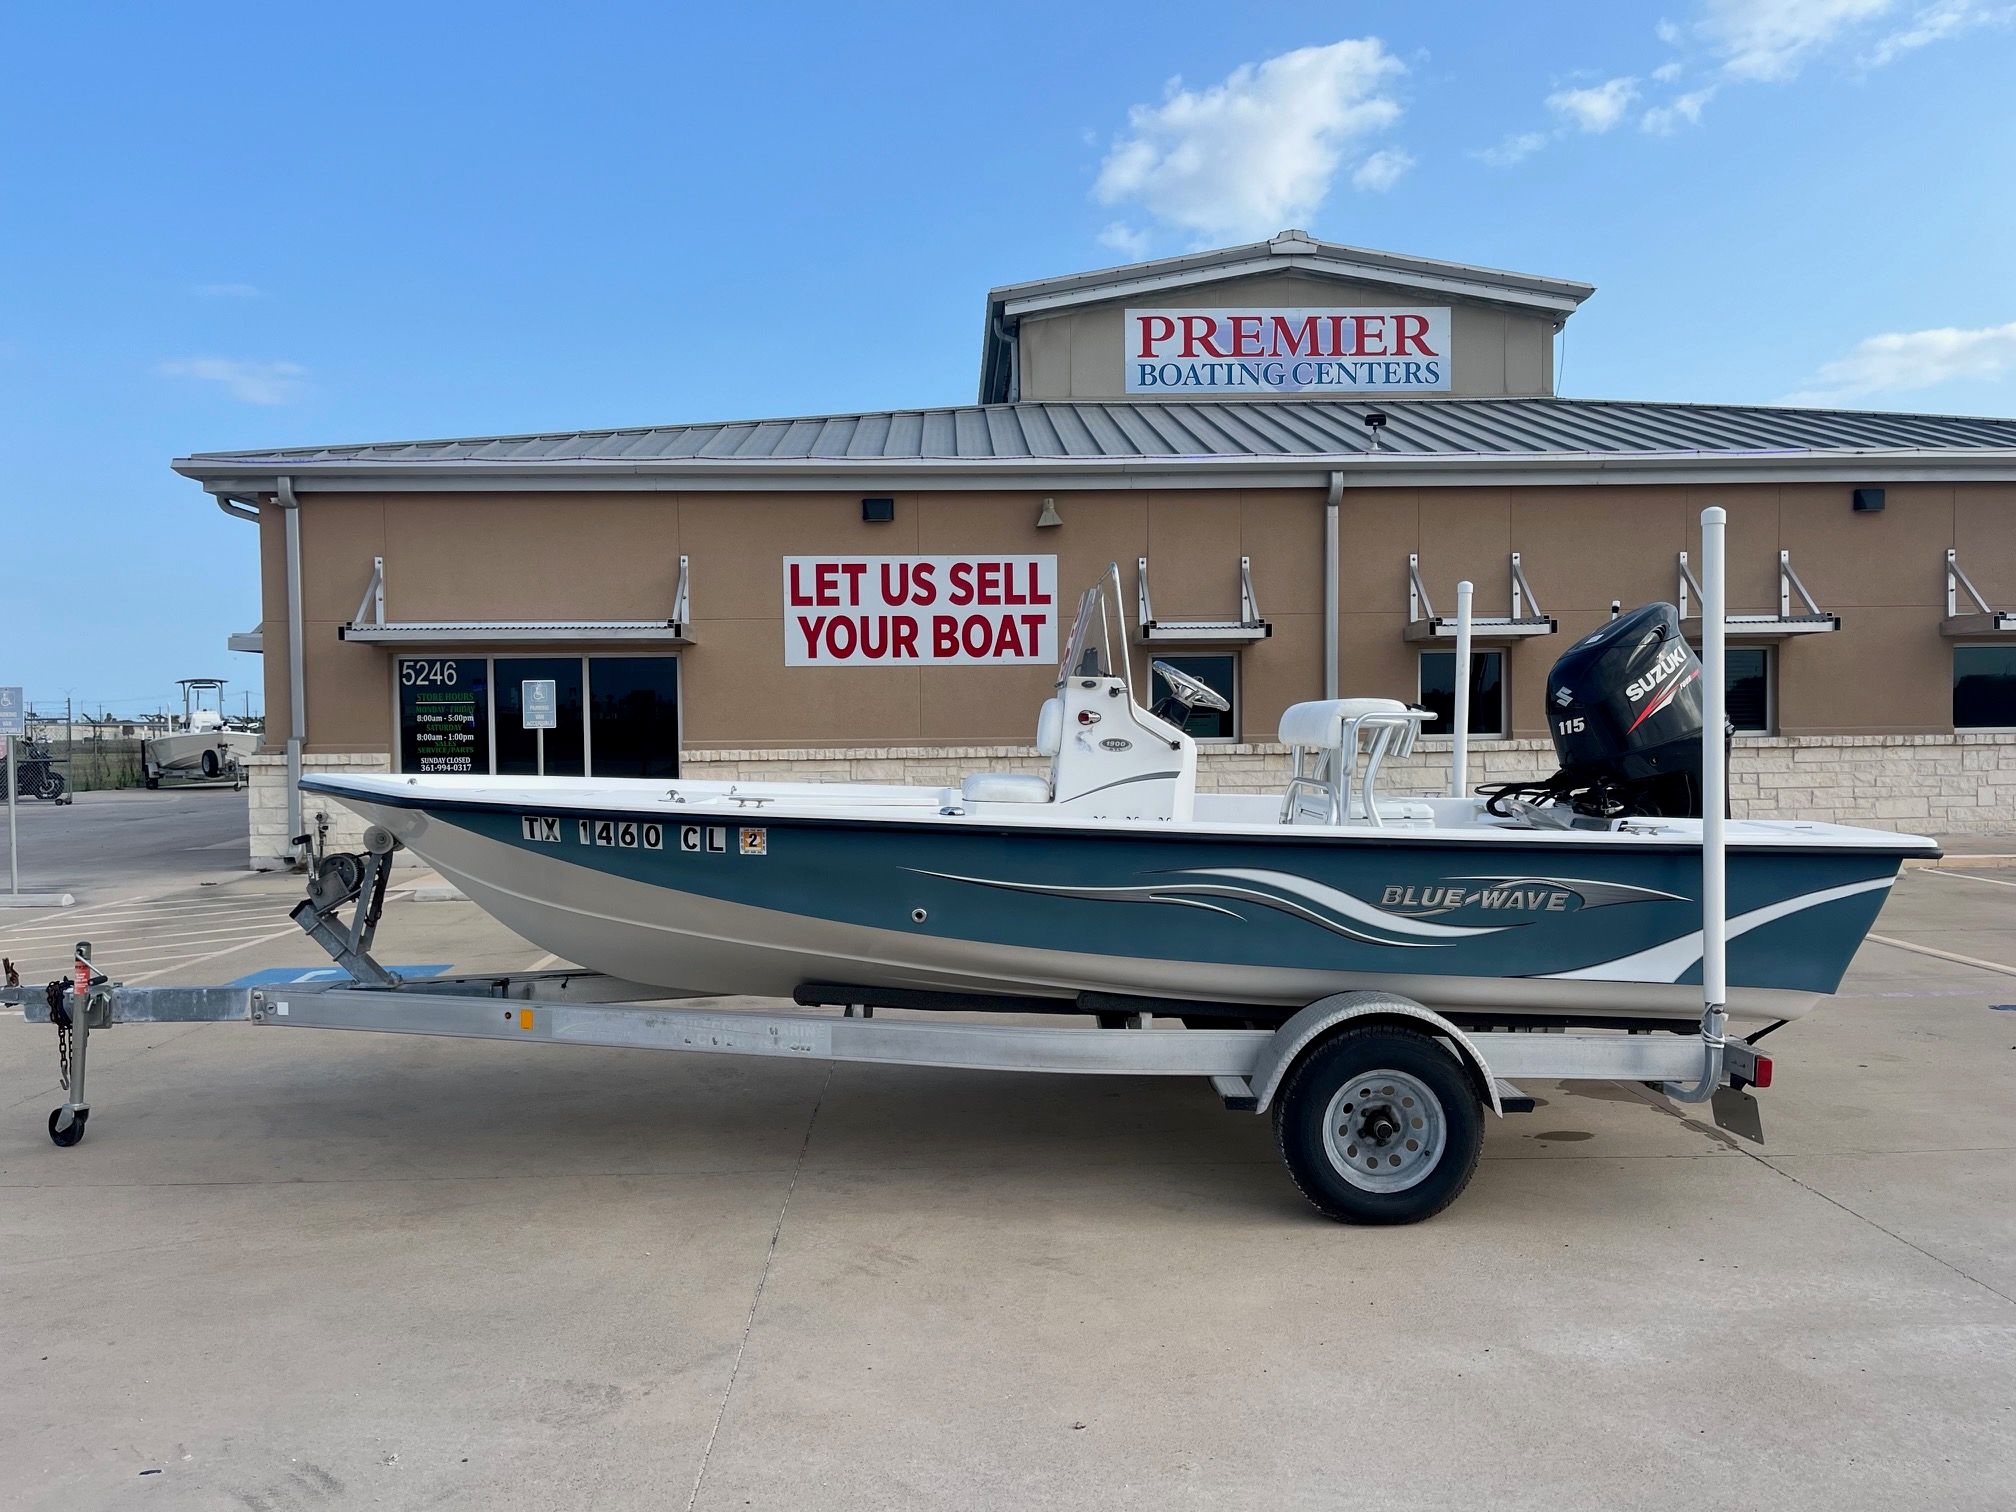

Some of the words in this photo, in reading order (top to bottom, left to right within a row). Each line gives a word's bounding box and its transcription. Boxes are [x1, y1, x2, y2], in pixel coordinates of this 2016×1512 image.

[1136, 314, 1440, 358] PREMIER
[1137, 362, 1287, 387] BOATING
[1292, 360, 1440, 385] CENTERS
[790, 563, 867, 607] LET
[880, 562, 937, 607] US
[949, 562, 1052, 606] SELL
[797, 614, 919, 660] YOUR
[932, 614, 1047, 659] BOAT
[402, 661, 457, 686] 5246
[1625, 645, 1687, 702] SUZUKI
[416, 692, 443, 701] STORE
[445, 692, 474, 701] HOURS
[416, 714, 443, 722] 8:00am
[447, 714, 475, 723] 5:00pm
[1558, 717, 1585, 736] 115
[416, 733, 443, 741] 8:00am
[448, 733, 475, 742] 1:00pm
[420, 764, 472, 772] 361-994-0317
[524, 817, 557, 841] TX
[580, 821, 661, 848] 1460
[682, 826, 724, 851] CL
[748, 833, 758, 848] 2
[1380, 885, 1467, 909] BLUE
[1479, 888, 1572, 912] WAVE
